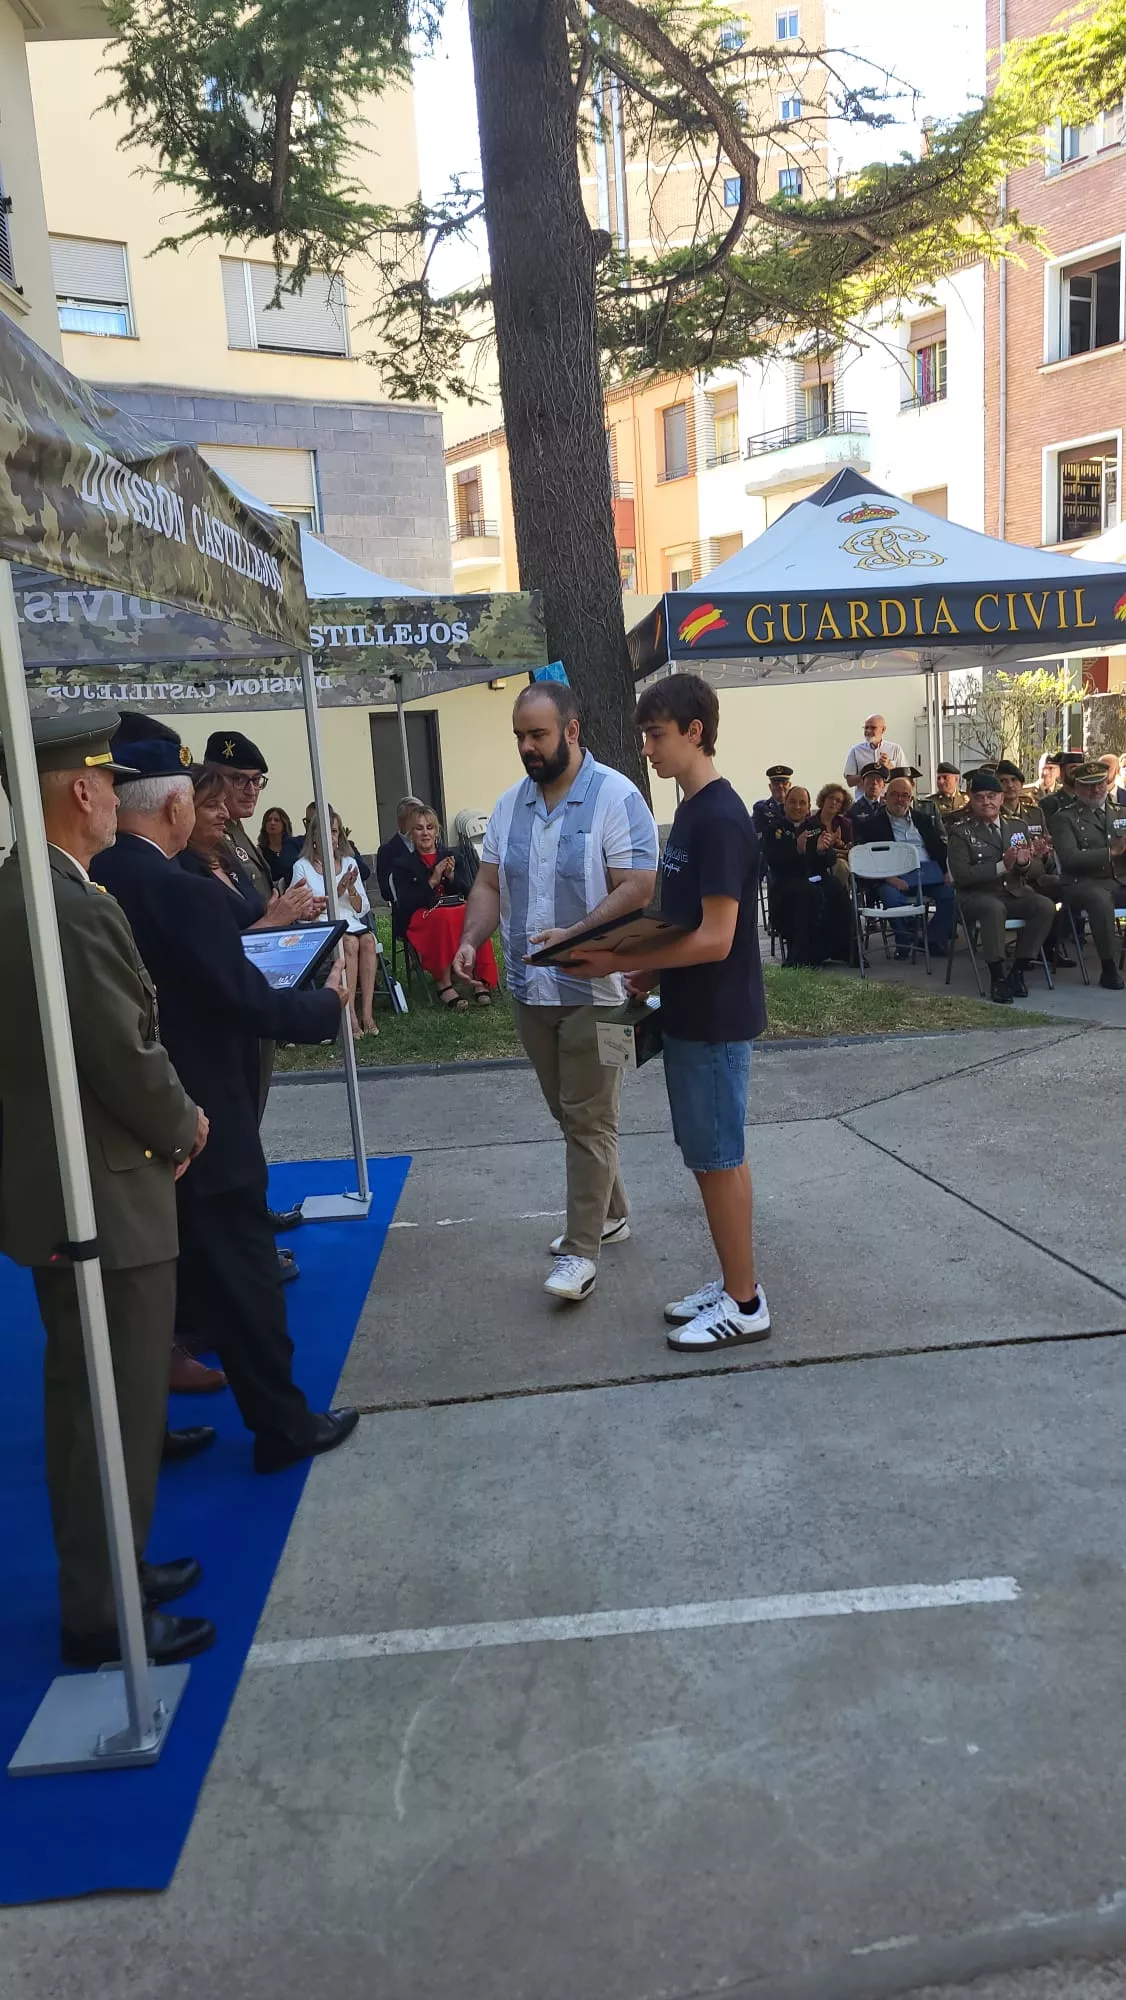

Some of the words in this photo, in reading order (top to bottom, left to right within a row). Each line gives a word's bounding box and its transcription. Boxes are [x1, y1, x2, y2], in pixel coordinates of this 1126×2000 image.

[191, 504, 284, 595] CASTILLEJOS
[309, 622, 469, 648] STILLEJOS
[745, 596, 961, 644] GUARDIA
[973, 588, 1098, 633] CIVIL
